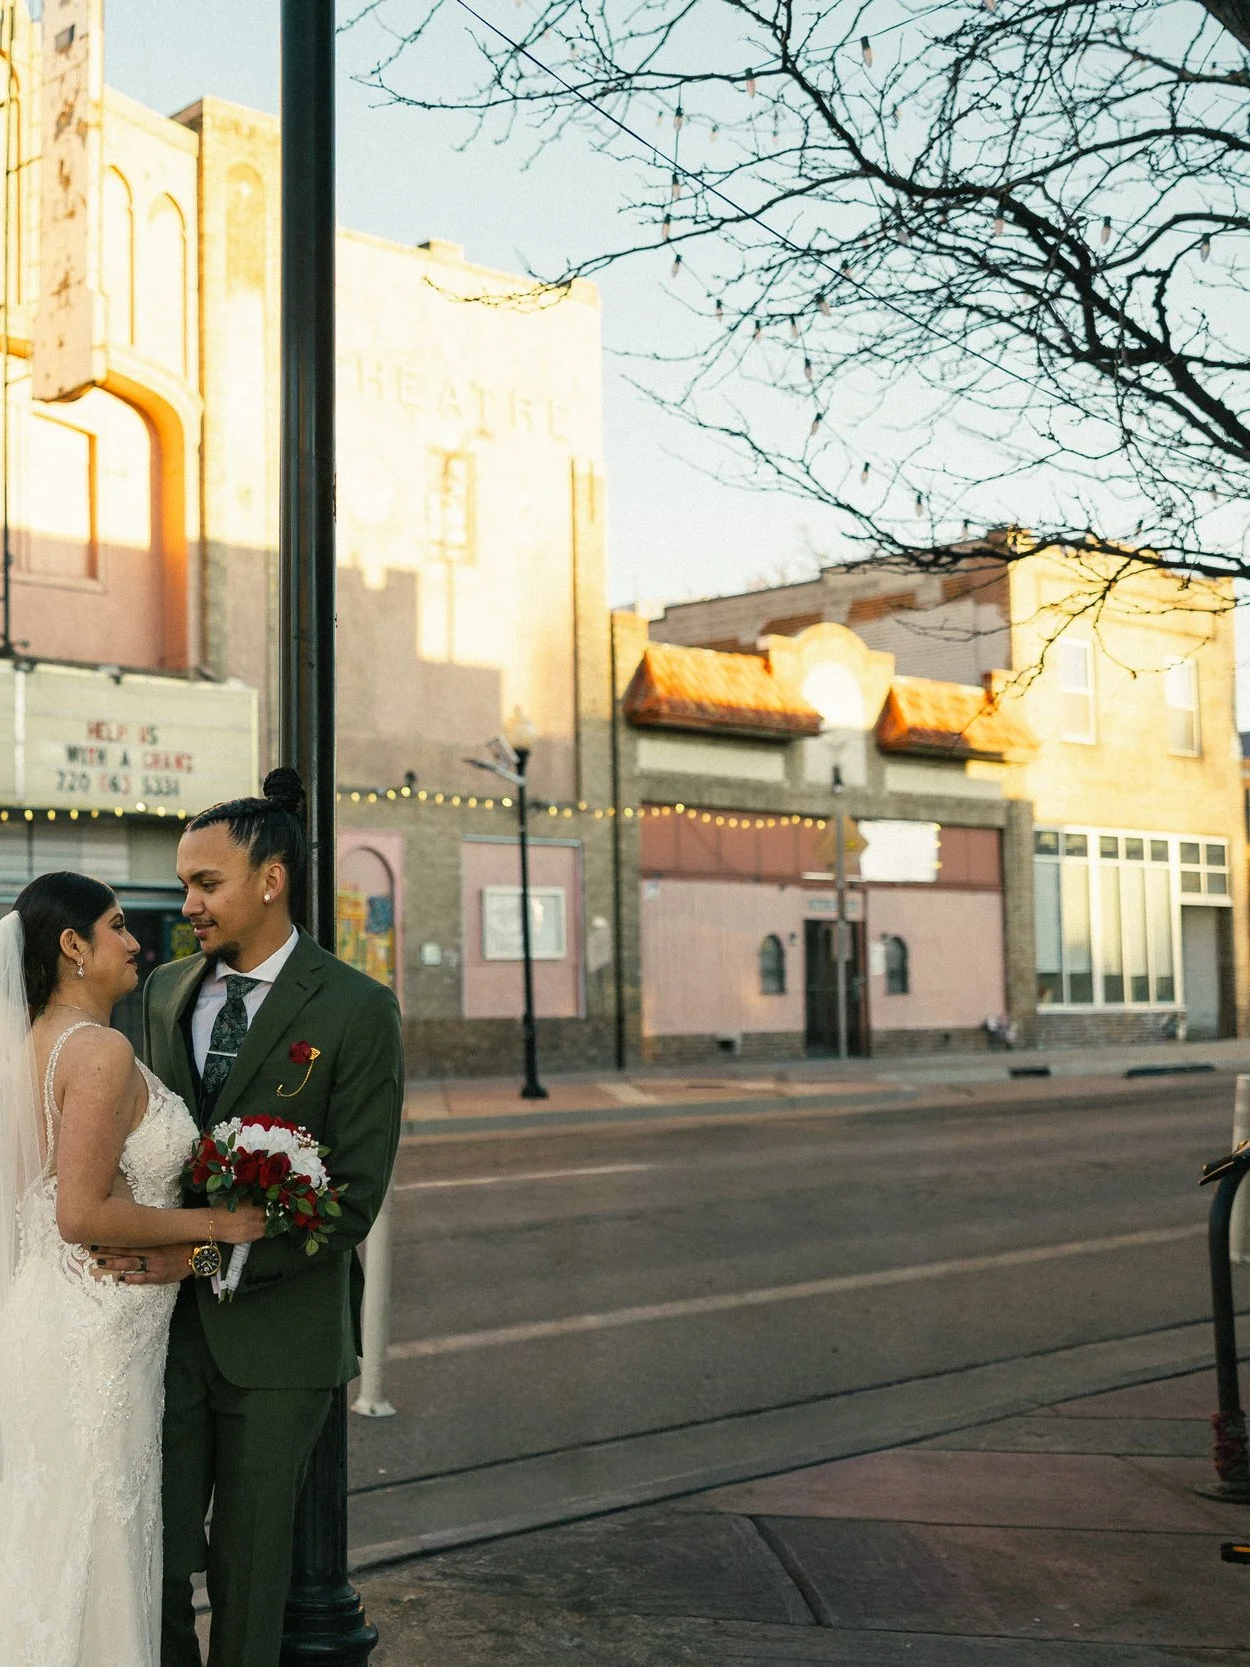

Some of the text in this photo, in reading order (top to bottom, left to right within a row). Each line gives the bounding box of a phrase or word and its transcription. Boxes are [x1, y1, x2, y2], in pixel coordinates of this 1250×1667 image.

[337, 352, 572, 444] HEATRE
[86, 721, 126, 743] HELP
[66, 744, 107, 768] WITH
[119, 749, 130, 768] A
[57, 769, 91, 793] 720
